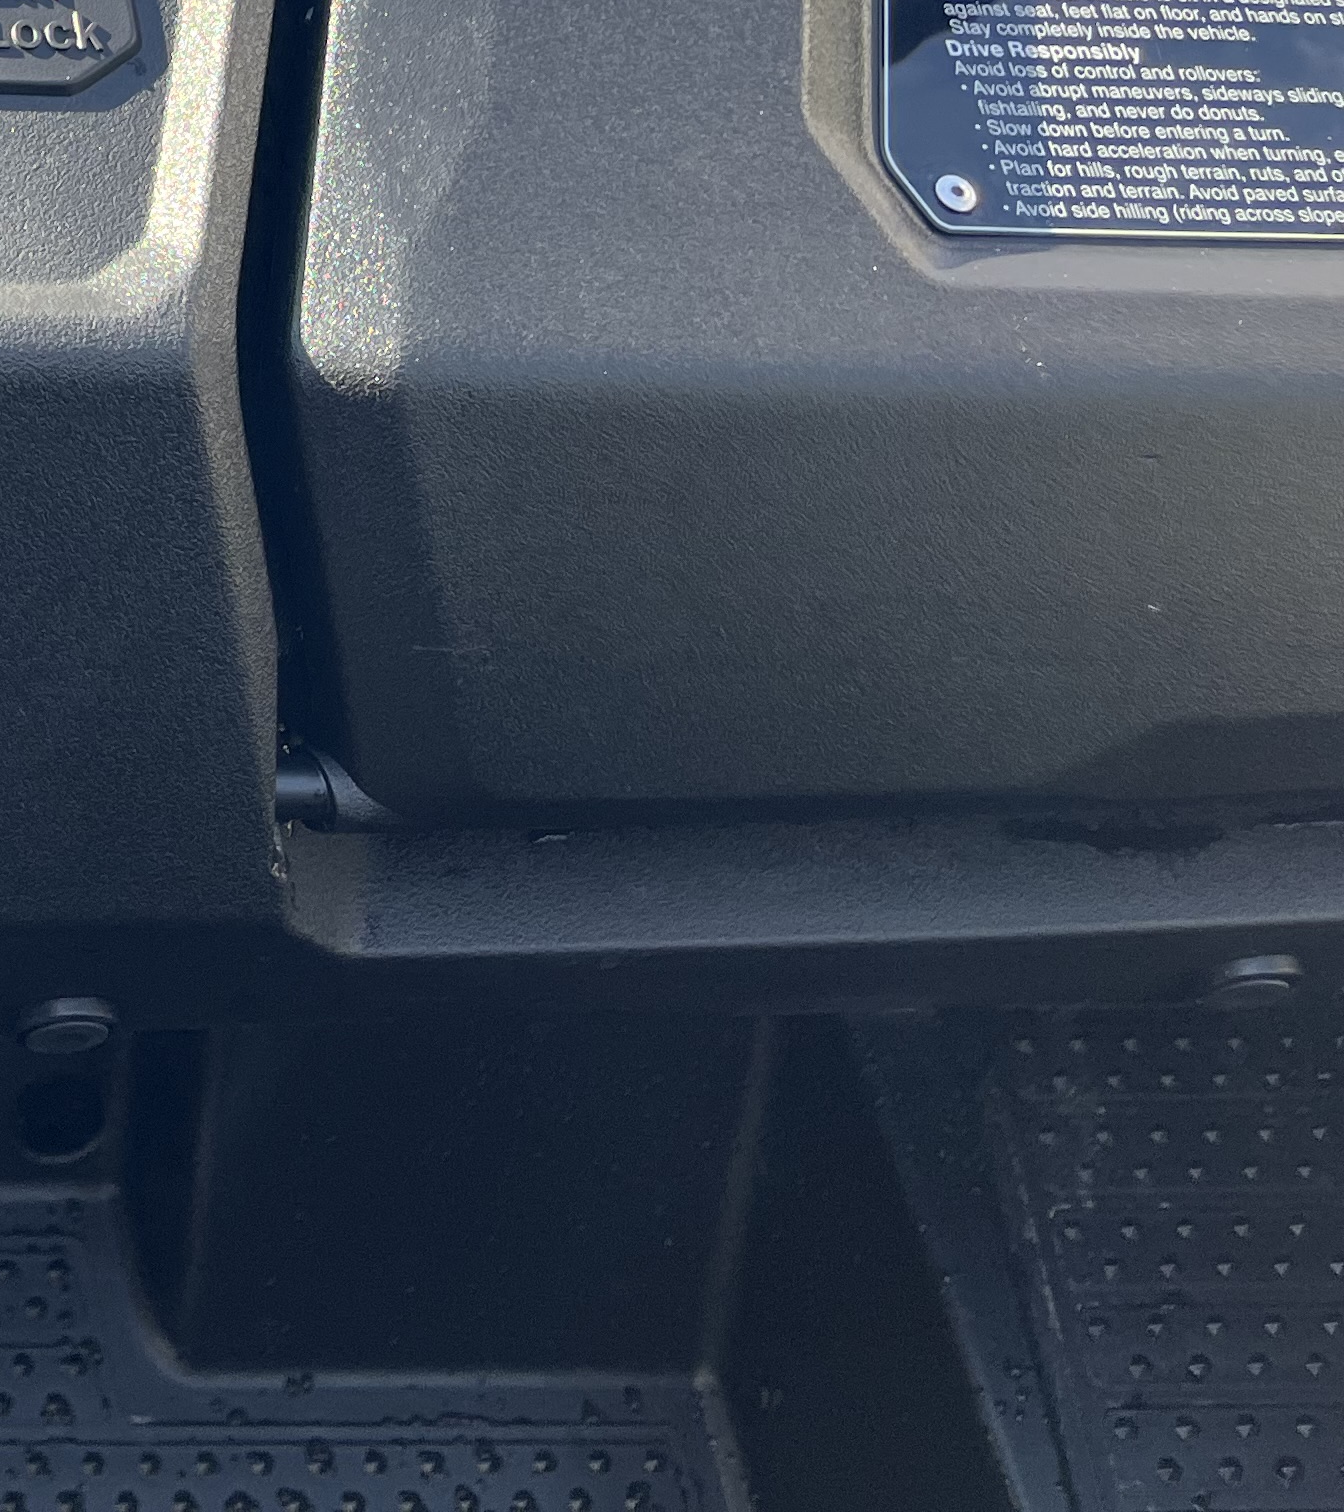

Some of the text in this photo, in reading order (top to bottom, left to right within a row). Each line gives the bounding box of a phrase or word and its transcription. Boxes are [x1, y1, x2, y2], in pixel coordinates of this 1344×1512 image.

[943, 0, 1011, 19] against
[1014, 3, 1059, 20] seat,
[1062, 2, 1098, 18] feet
[1100, 2, 1131, 19] flat
[1134, 8, 1158, 20] on
[1160, 4, 1207, 23] floor,
[1209, 7, 1243, 22] and
[1244, 7, 1301, 24] hands
[1303, 12, 1327, 25] on
[949, 18, 1256, 42] Stay completely inside the vehicle.
[945, 39, 1140, 64] Drive Responsibly
[954, 60, 1005, 77] Avoid
[1009, 62, 1048, 78] loss
[1051, 62, 1070, 78] of
[1074, 64, 1137, 80] control
[1141, 64, 1175, 81] and
[973, 80, 1025, 96] Avoid
[1029, 82, 1089, 101] abrupt
[1091, 85, 1199, 103] maneuvers,
[1202, 85, 1285, 105] sideways
[977, 99, 1265, 121] fishtailing, and never do donuts.
[986, 119, 1291, 144] Slow down before entering a turn.
[994, 139, 1045, 156] Avoid
[1047, 141, 1092, 157] hard
[1096, 143, 1207, 159] acceleration
[1210, 144, 1261, 160] when
[1262, 145, 1331, 166] turning,
[1000, 159, 1044, 176] Plan
[1046, 160, 1073, 177] for
[1076, 161, 1121, 180] hills,
[1124, 163, 1178, 183] rough
[1181, 164, 1247, 182] terrain,
[1249, 166, 1291, 184] ruts,
[1293, 167, 1328, 183] and
[1006, 181, 1076, 197] traction
[1080, 182, 1116, 198] and
[1119, 183, 1185, 200] terrain.
[1189, 184, 1239, 201] Avoid
[1243, 186, 1300, 204] paved
[1016, 200, 1067, 218] Avoid
[1071, 202, 1111, 219] side
[1113, 202, 1170, 224] hilling
[1173, 203, 1232, 225] (riding
[1234, 209, 1295, 223] across
